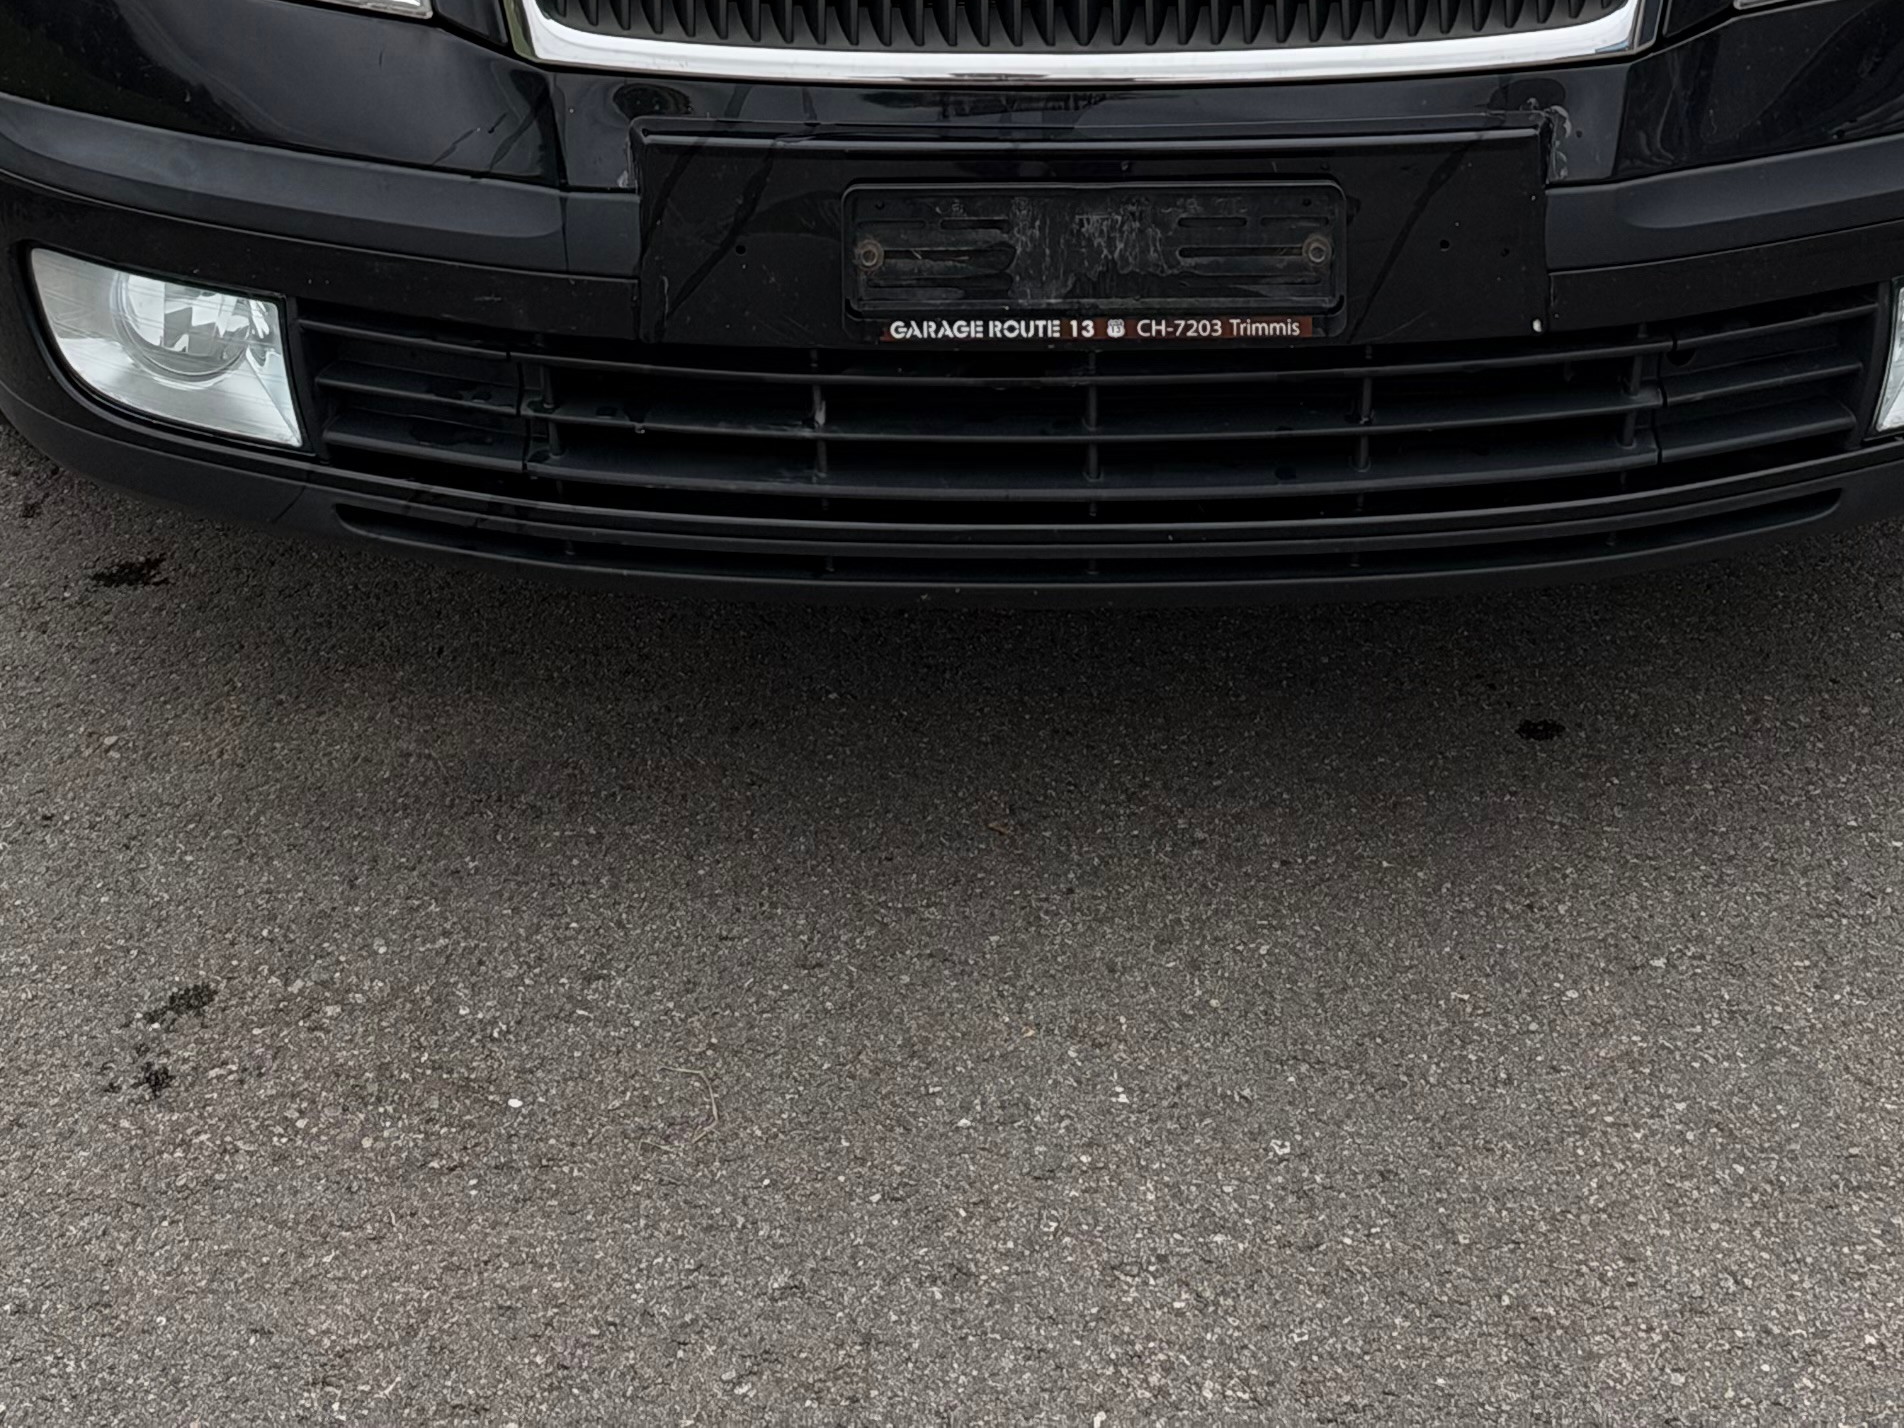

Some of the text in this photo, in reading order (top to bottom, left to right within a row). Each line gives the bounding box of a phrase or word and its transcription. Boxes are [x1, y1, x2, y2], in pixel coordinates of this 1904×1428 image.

[890, 320, 983, 339] GARAGE
[988, 319, 1061, 338] ROUTE
[1069, 319, 1095, 338] 13
[1136, 319, 1223, 337] CH-7203
[1229, 318, 1301, 336] Trimmis
